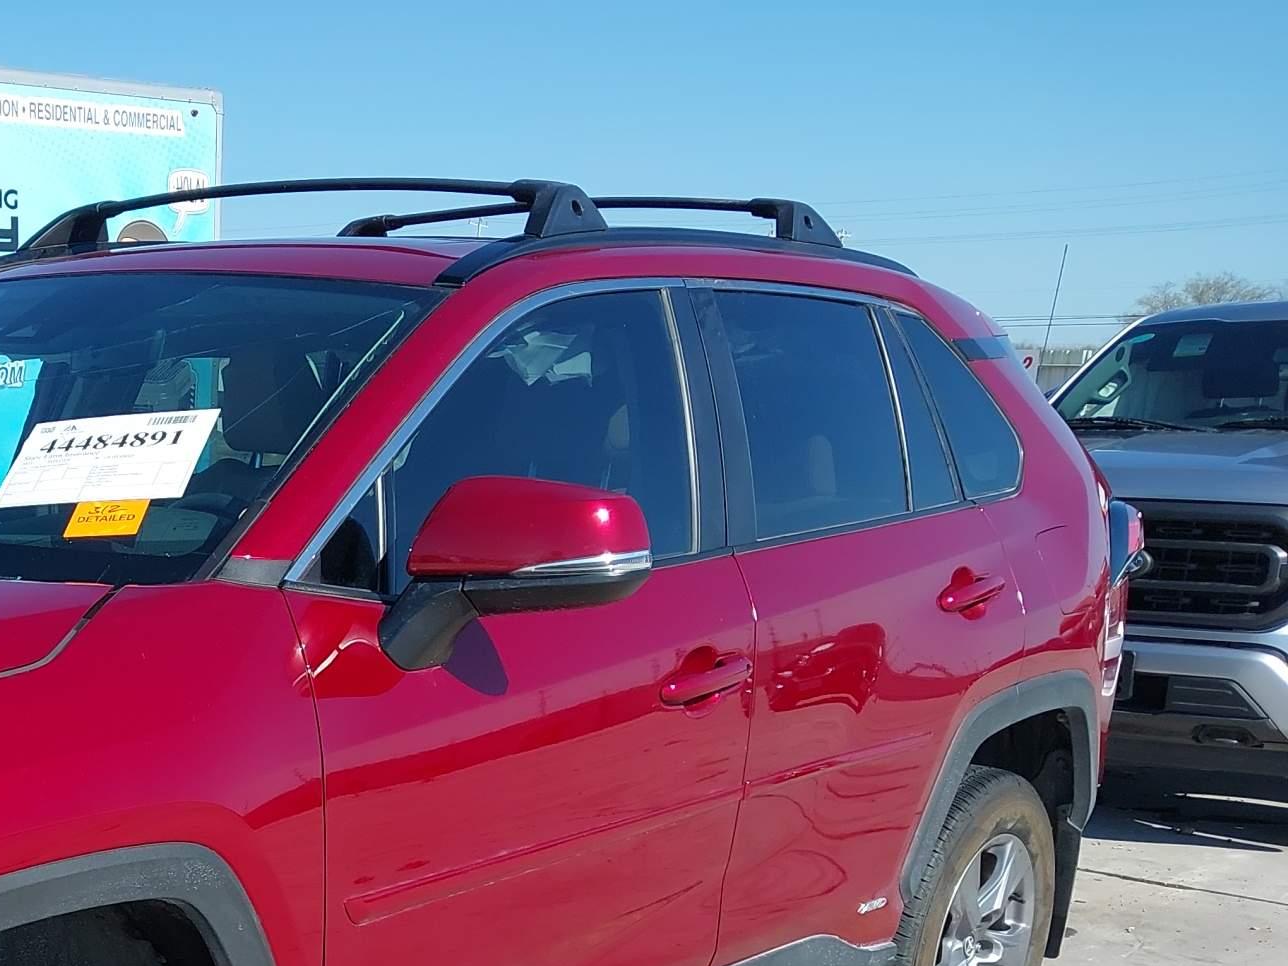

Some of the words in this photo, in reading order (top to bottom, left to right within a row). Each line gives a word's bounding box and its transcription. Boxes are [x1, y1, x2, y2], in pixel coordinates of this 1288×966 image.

[29, 102, 100, 125] RESIDENTIAL
[103, 110, 111, 125] &
[113, 110, 183, 132] COMMERCIAL
[40, 429, 184, 454] 44484891
[77, 513, 136, 524] DETAILED
